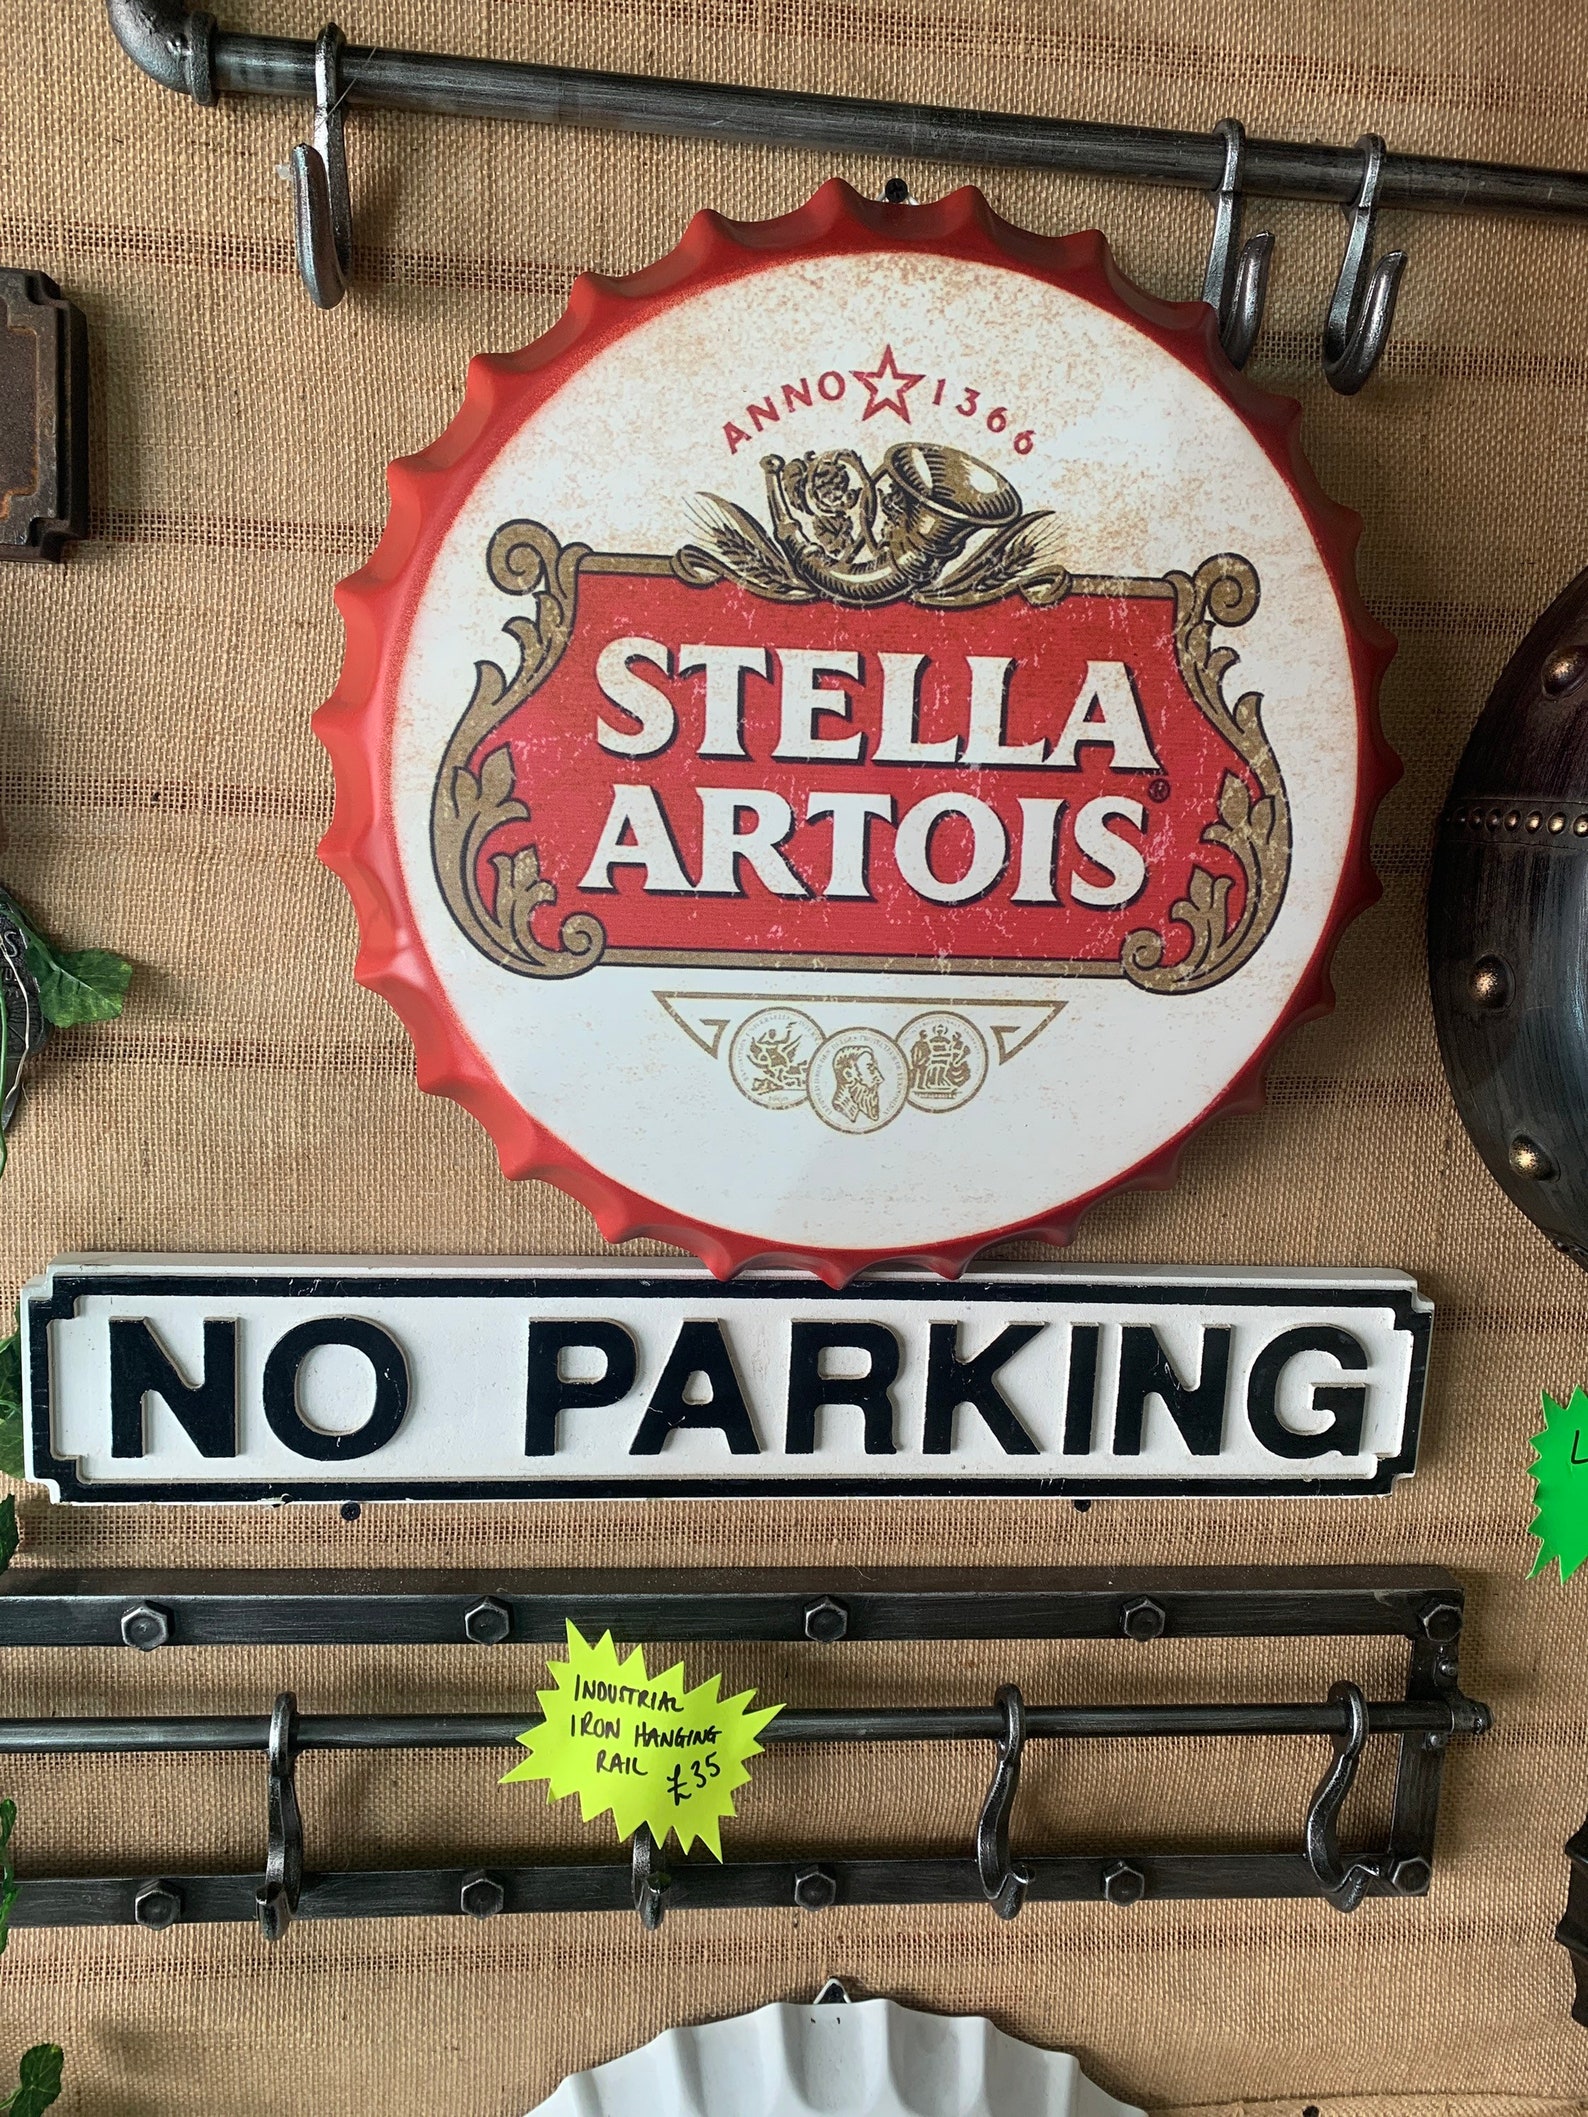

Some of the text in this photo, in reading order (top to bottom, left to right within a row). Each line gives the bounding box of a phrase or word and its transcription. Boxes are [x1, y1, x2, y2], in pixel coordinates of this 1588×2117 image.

[722, 370, 1036, 455] ANNO 1366
[596, 636, 1166, 773] STELLA
[576, 783, 1149, 907] ARTOIS
[109, 1314, 1372, 1462] NO PARKING
[571, 1711, 722, 1748] IRON HANGING
[574, 1674, 684, 1712] INDUSTRIAL
[596, 1749, 721, 1806] RAIL £35
